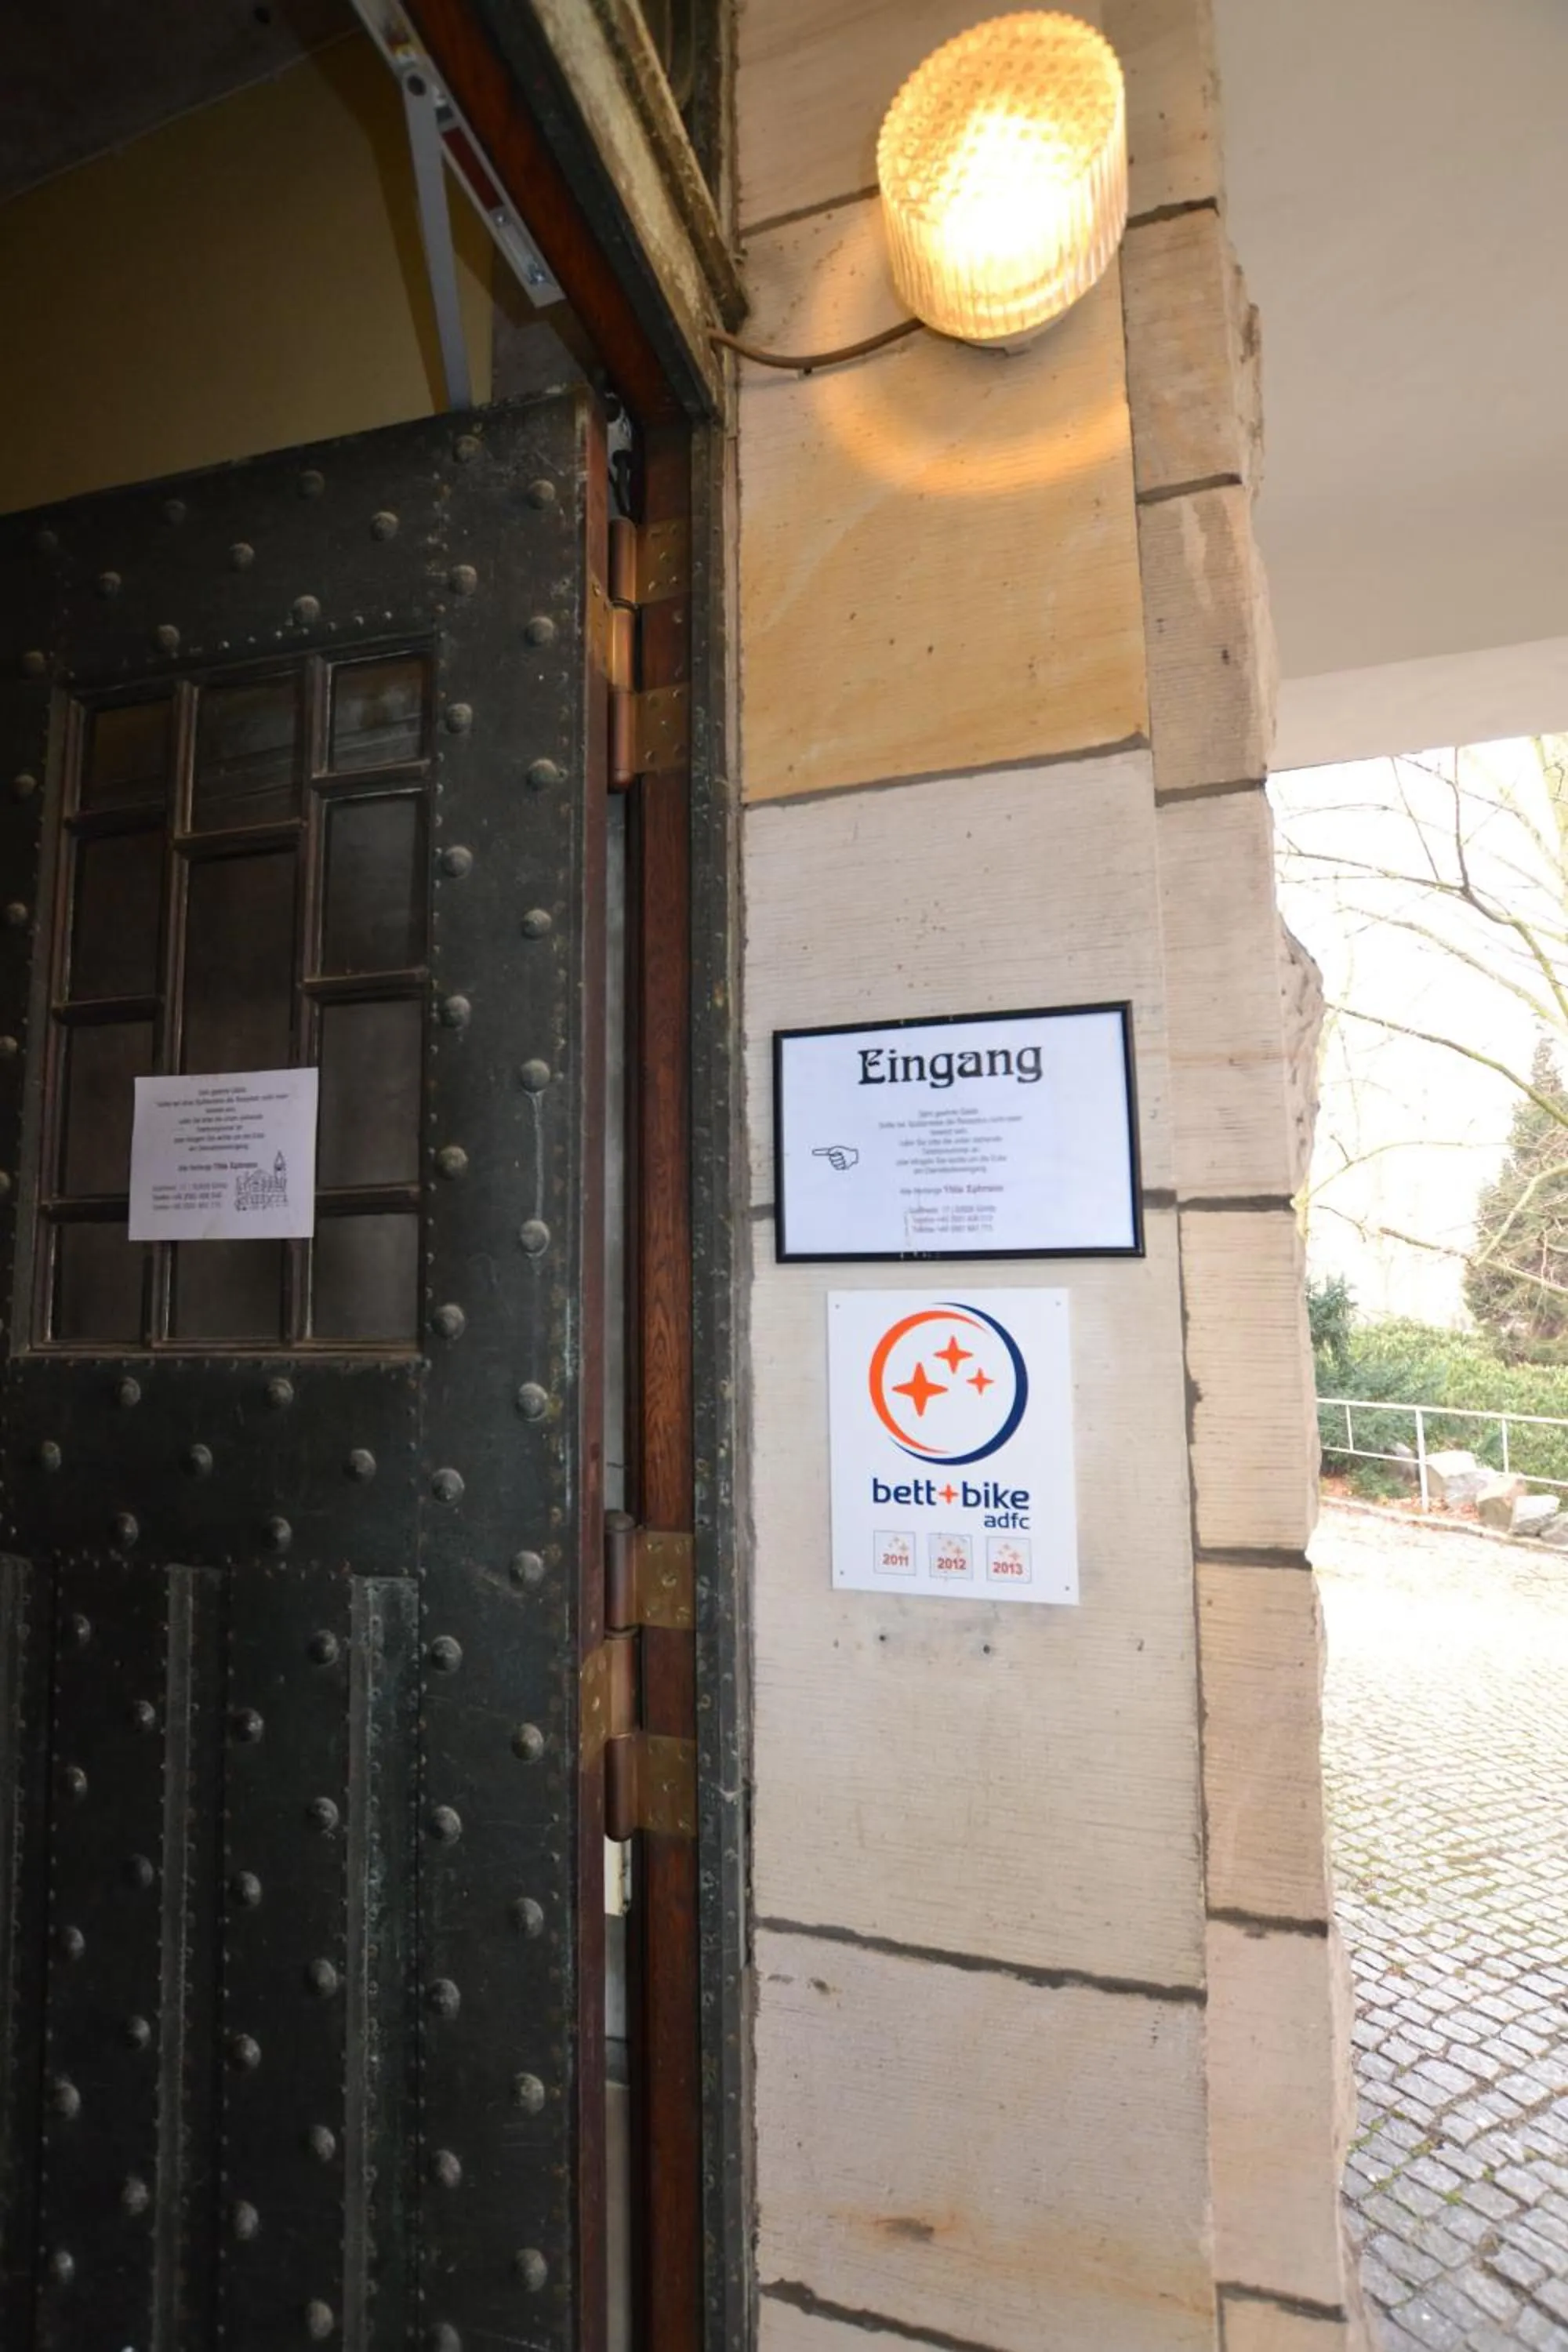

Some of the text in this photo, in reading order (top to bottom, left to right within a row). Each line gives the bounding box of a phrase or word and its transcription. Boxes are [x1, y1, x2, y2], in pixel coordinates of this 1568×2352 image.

[858, 1046, 1042, 1088] Eingang
[983, 1512, 1030, 1530] adfc
[882, 1552, 1024, 1575] 2011 2012 2013
